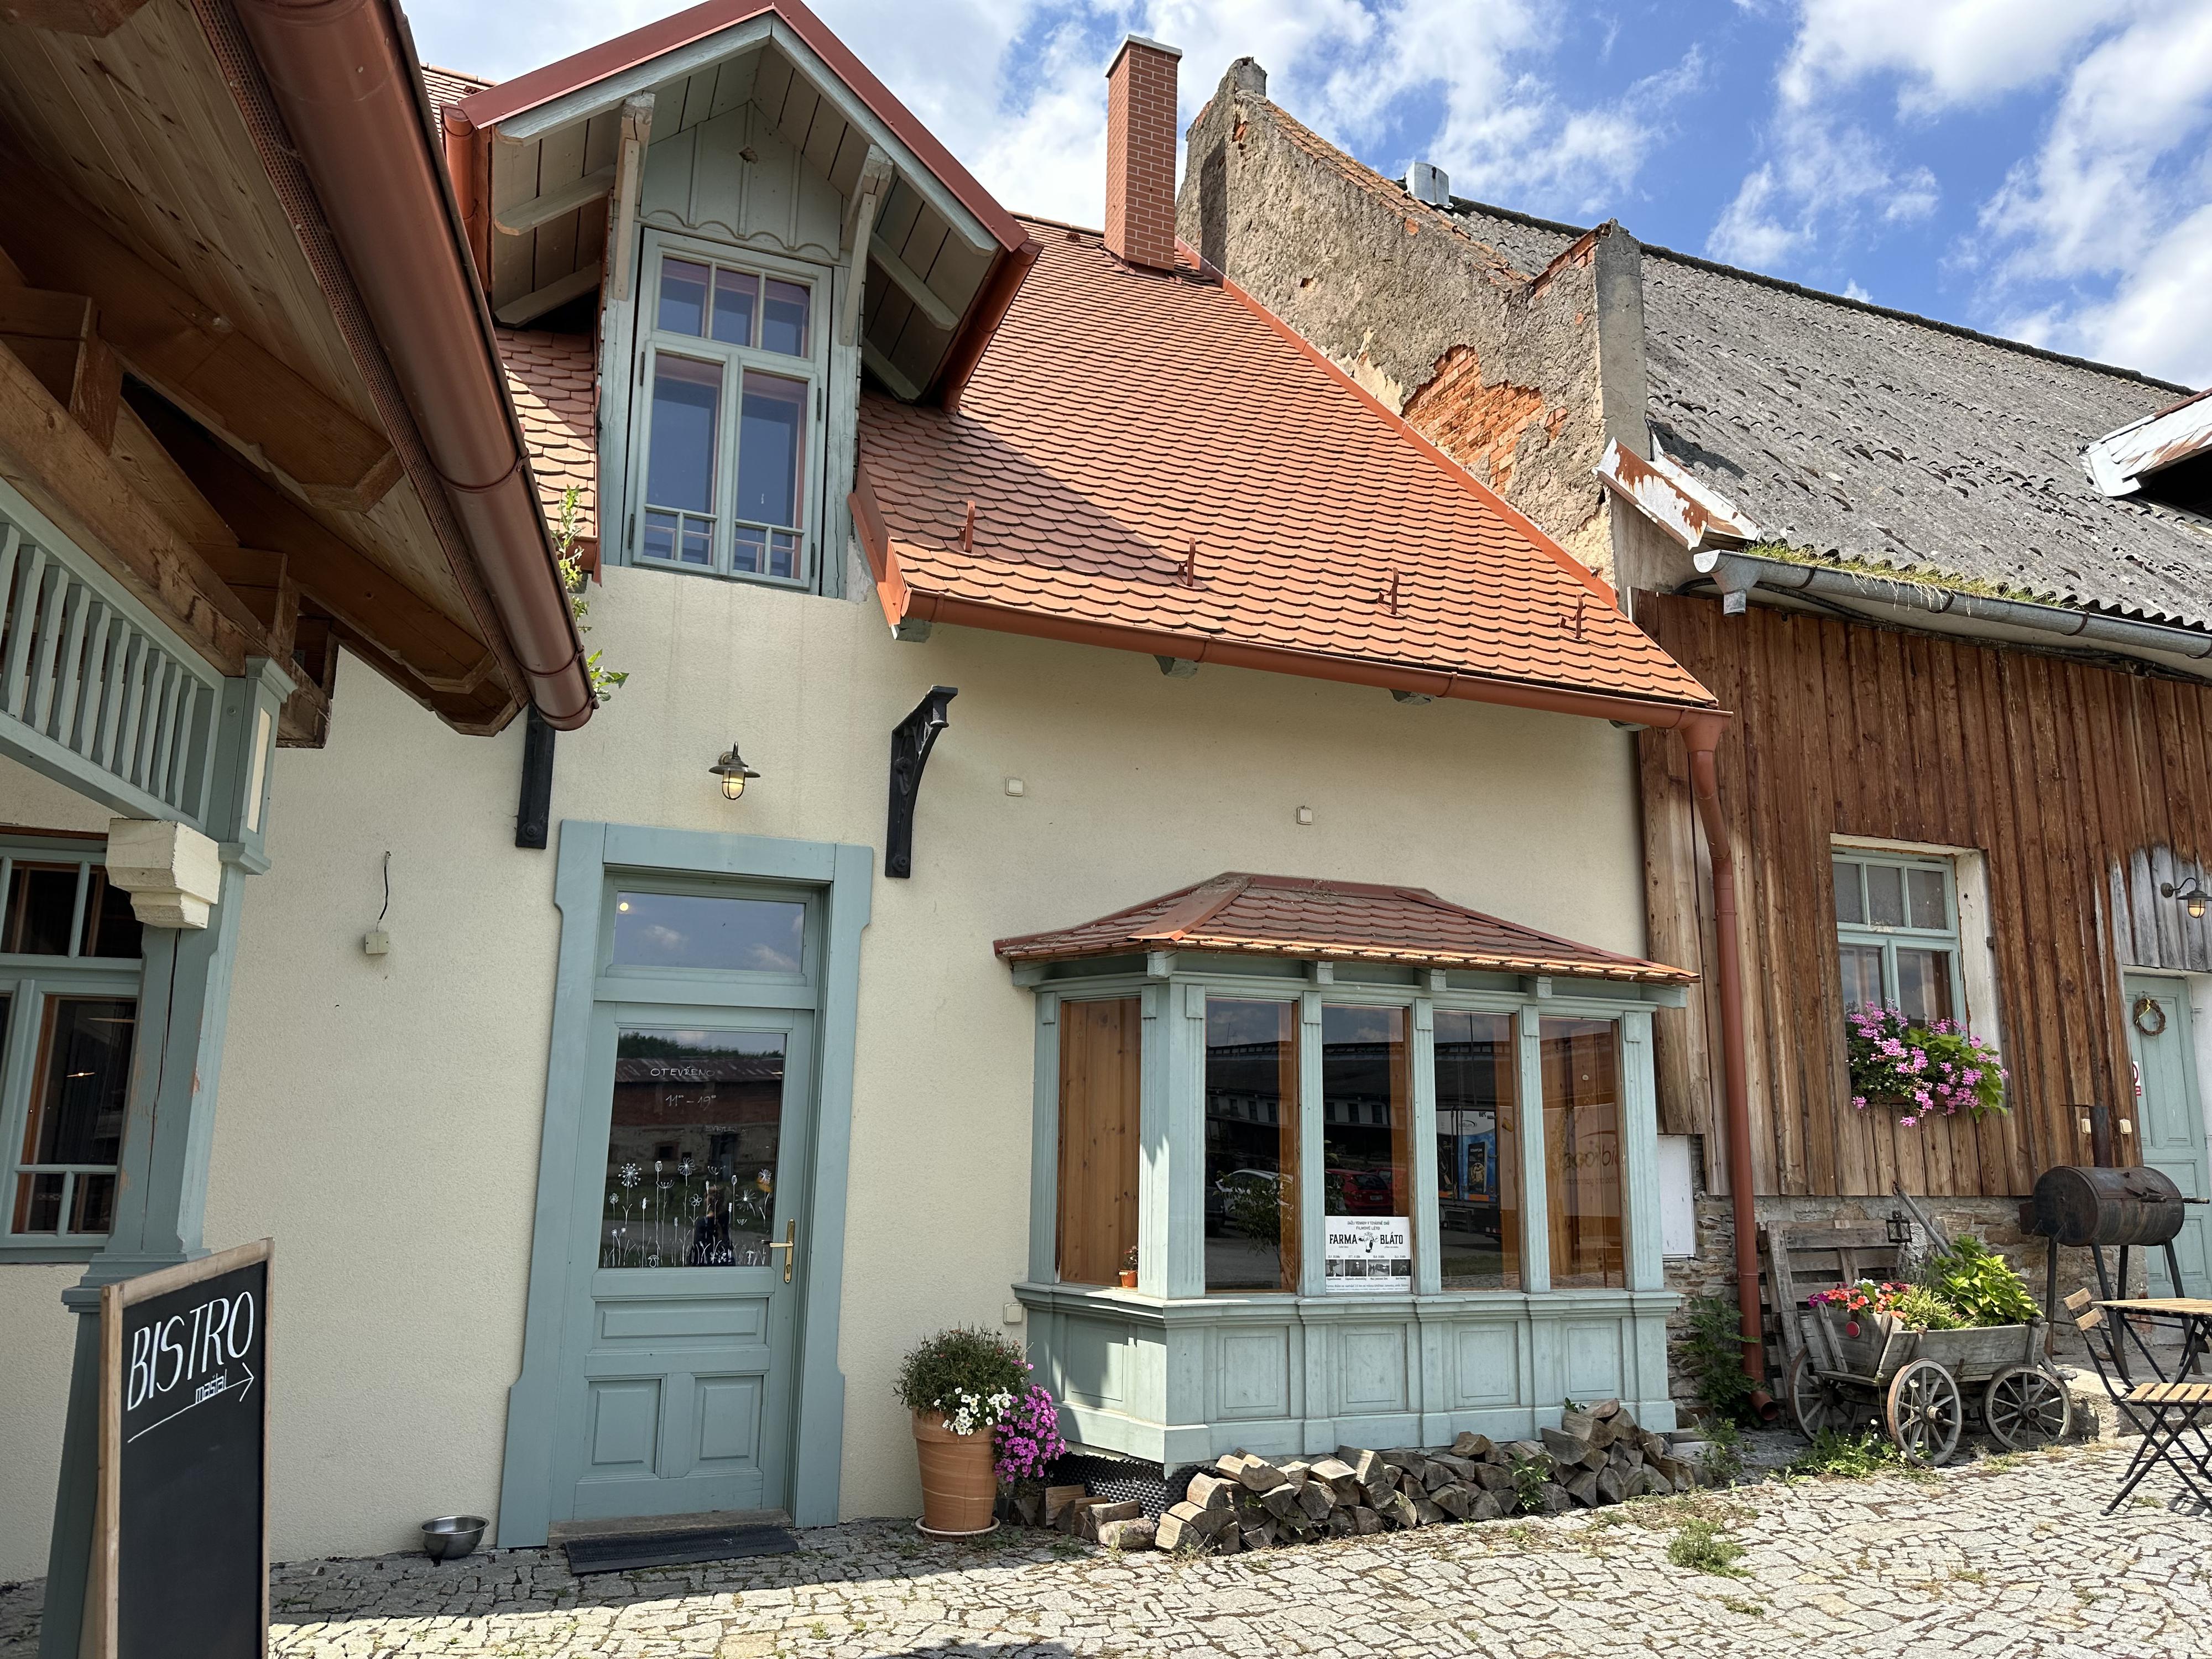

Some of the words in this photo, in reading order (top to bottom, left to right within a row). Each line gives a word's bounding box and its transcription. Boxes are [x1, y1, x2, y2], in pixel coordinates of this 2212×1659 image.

[650, 1066, 715, 1077] OTEVŘENO
[1329, 1234, 1358, 1244] FARMA
[1380, 1232, 1403, 1244] BLÁTO
[127, 1291, 254, 1411] BISTRO
